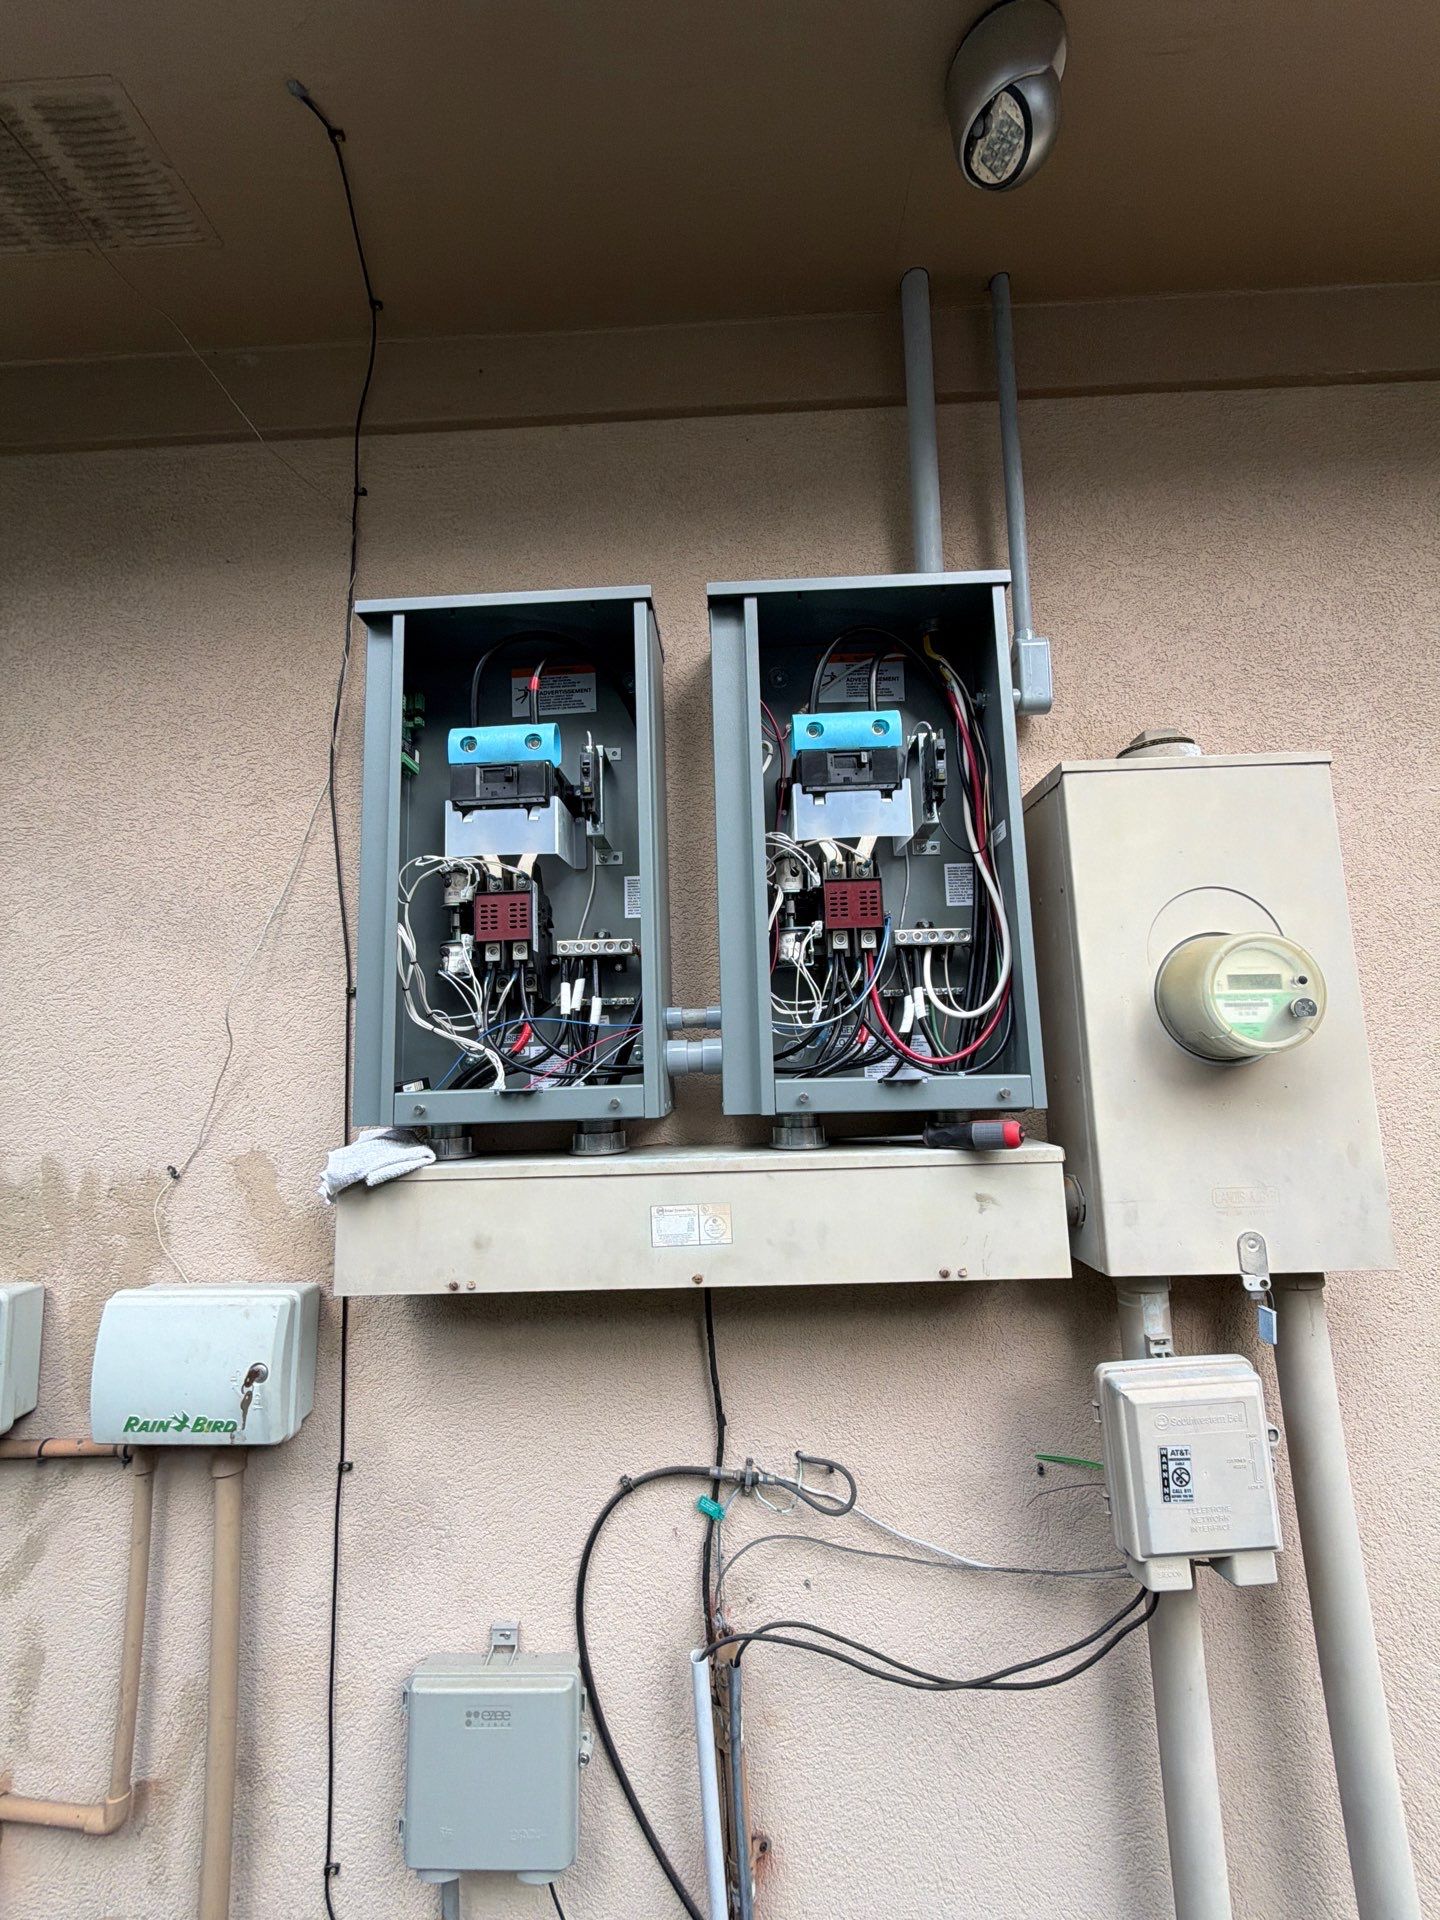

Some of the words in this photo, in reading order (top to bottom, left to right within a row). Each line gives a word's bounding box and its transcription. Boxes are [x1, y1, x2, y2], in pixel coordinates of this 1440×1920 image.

[123, 1416, 172, 1433] RAIN
[190, 1416, 238, 1433] BIRD
[1170, 1449, 1190, 1457] AT&T
[1160, 1449, 1170, 1502] WARNING
